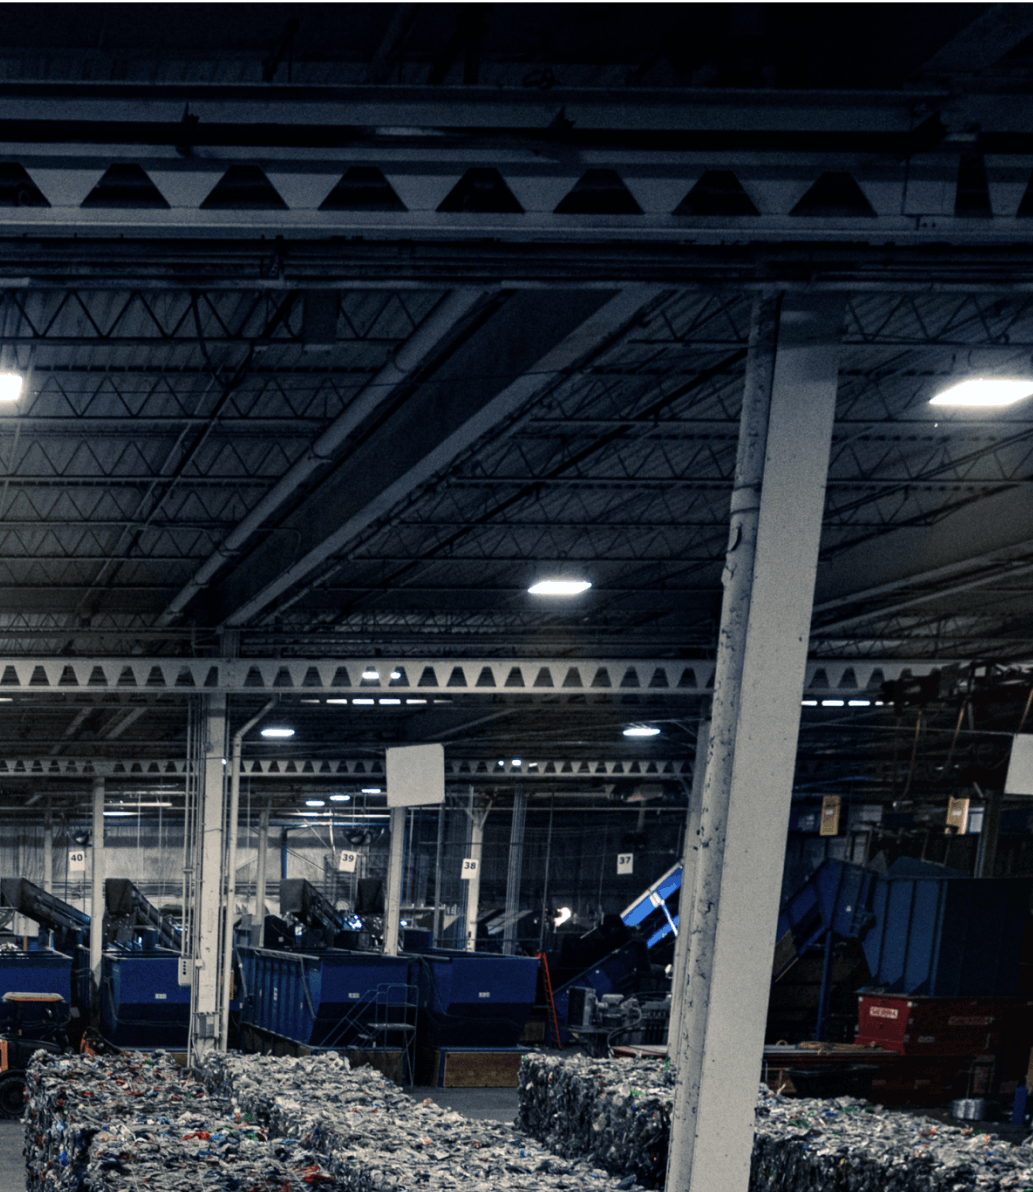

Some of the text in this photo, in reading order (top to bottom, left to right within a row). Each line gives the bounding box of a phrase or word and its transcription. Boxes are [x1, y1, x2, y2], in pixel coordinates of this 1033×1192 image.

[71, 854, 83, 862] 40
[342, 853, 355, 862] 39
[619, 856, 631, 865] 37
[464, 861, 477, 870] 38
